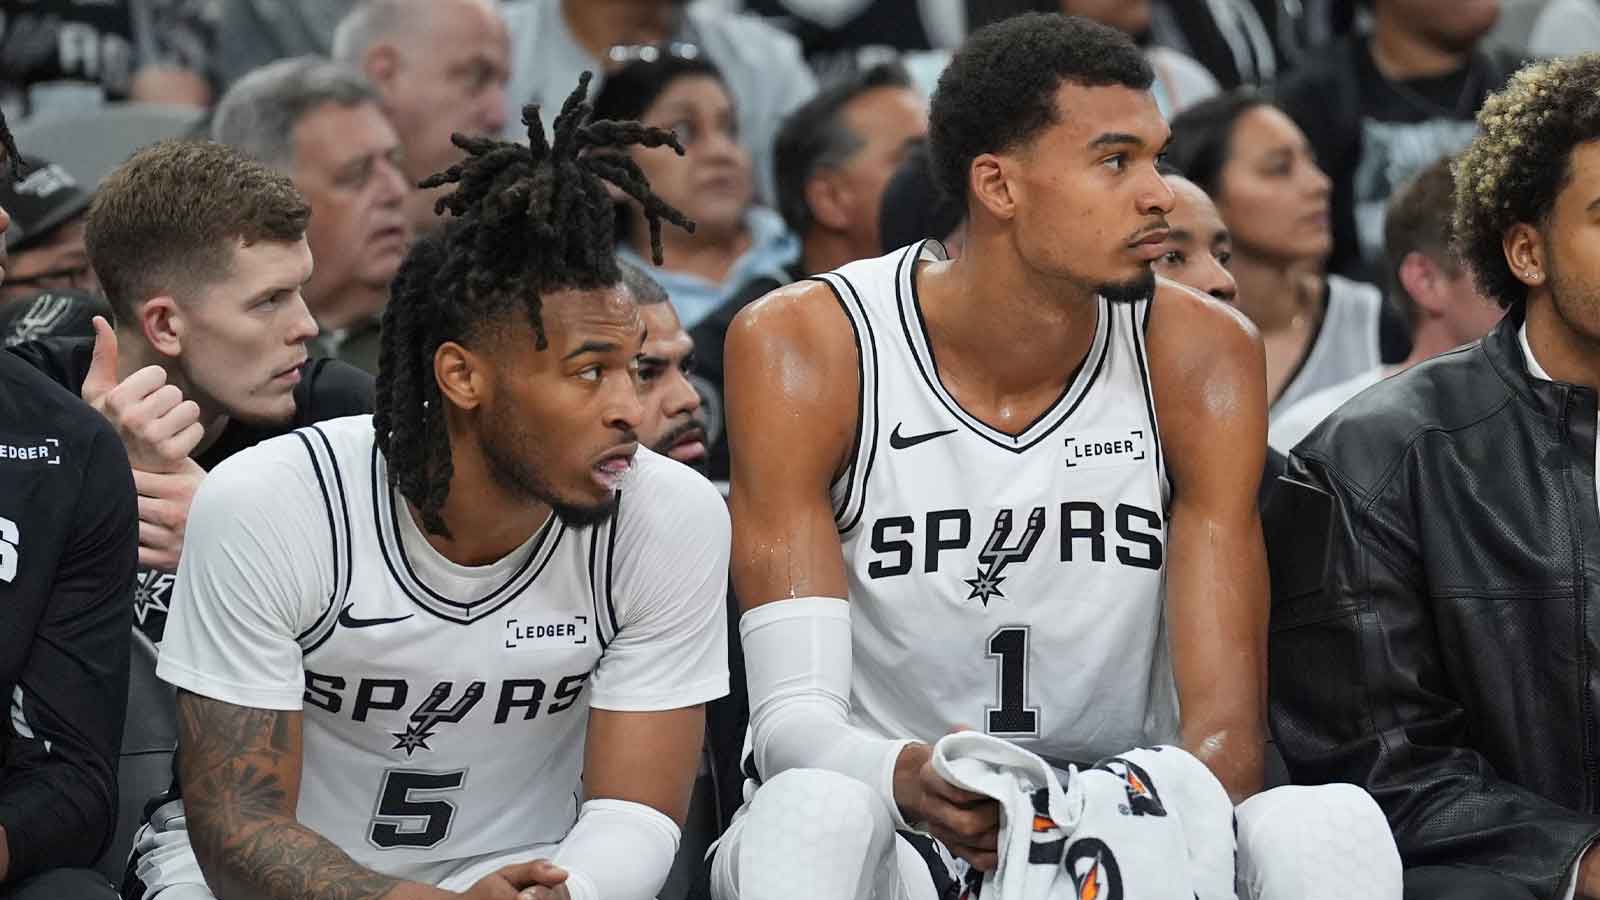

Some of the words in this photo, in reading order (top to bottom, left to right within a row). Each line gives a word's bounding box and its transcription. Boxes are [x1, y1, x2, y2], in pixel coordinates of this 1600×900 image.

[0, 445, 49, 460] EDGER
[1075, 440, 1133, 458] LEDGER
[868, 501, 1163, 608] SPURS
[516, 624, 576, 639] LEDGER
[303, 670, 591, 756] SPURS
[984, 625, 1041, 738] 1
[368, 767, 469, 850] 5
